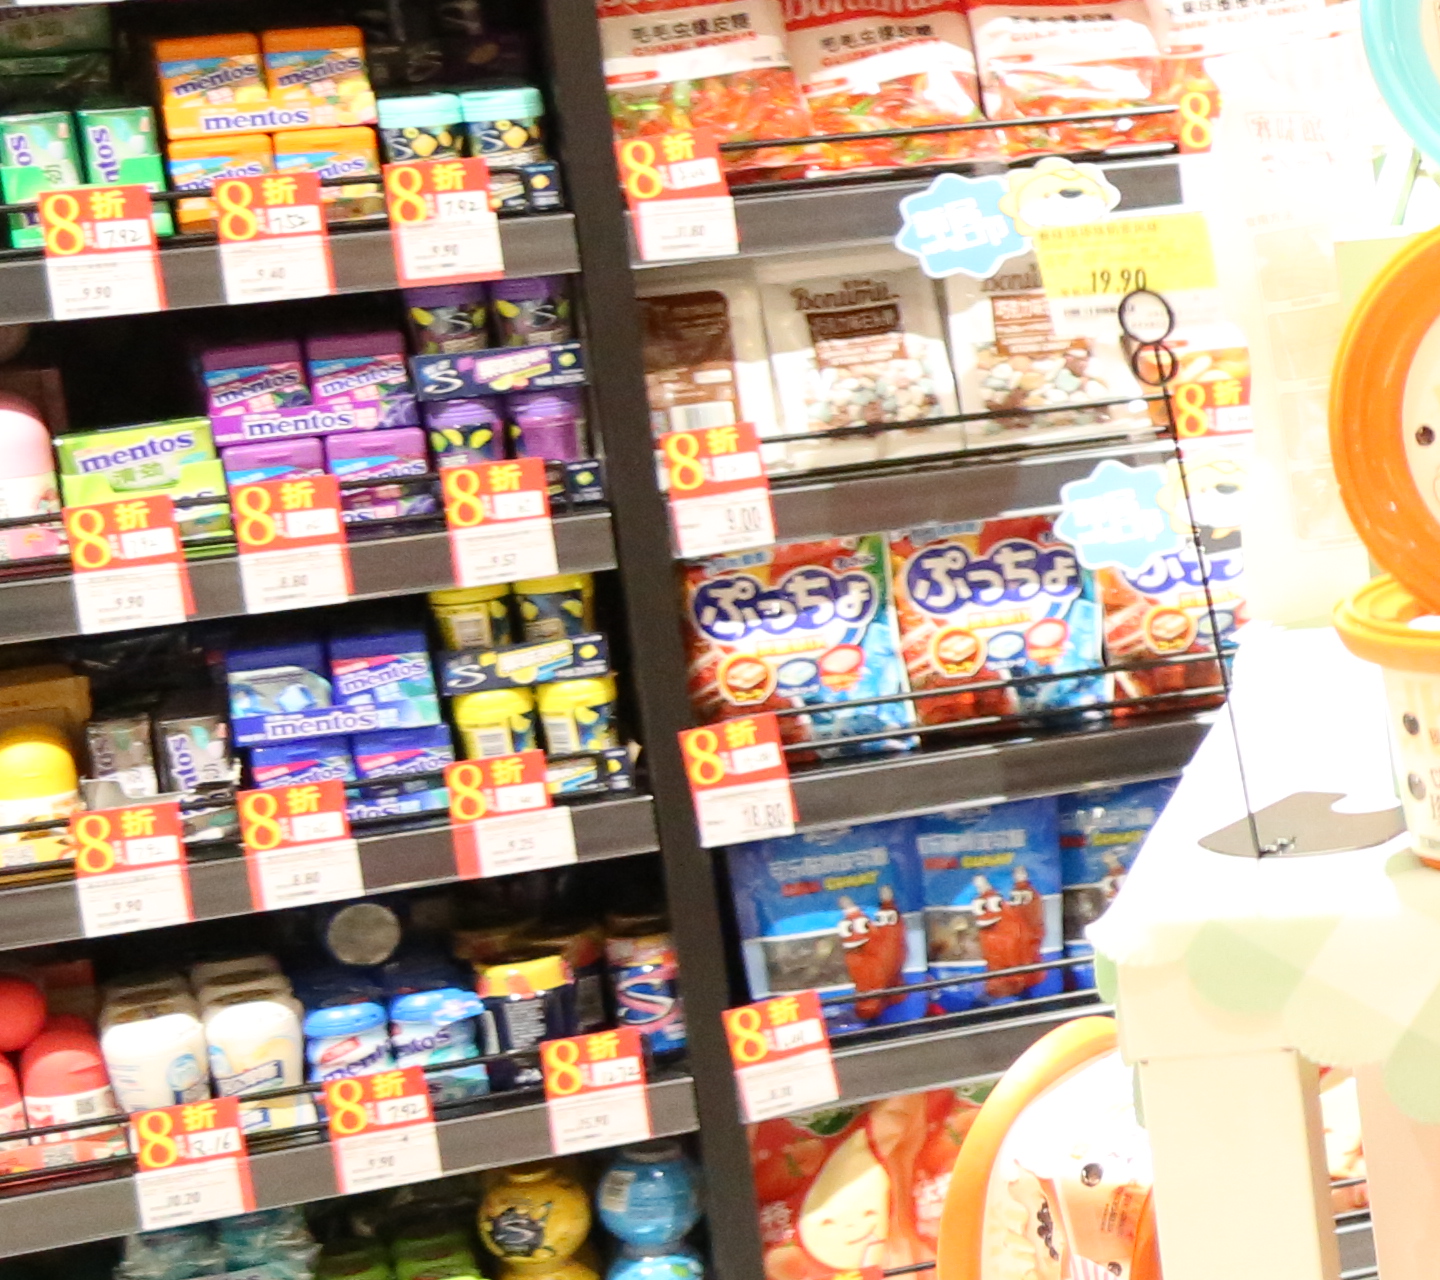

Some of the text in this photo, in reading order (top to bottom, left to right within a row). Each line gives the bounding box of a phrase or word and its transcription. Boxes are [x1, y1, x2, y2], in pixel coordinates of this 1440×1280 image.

[172, 62, 258, 98] mentos
[278, 53, 362, 88] mentos
[203, 107, 311, 131] mentos
[1090, 268, 1147, 294] 19.90
[212, 368, 299, 408] mentos
[320, 361, 404, 397] mentos
[246, 410, 354, 438] mentos
[80, 431, 195, 475] mentos
[912, 551, 1078, 613] ぷっちょ
[264, 708, 379, 739] mentos
